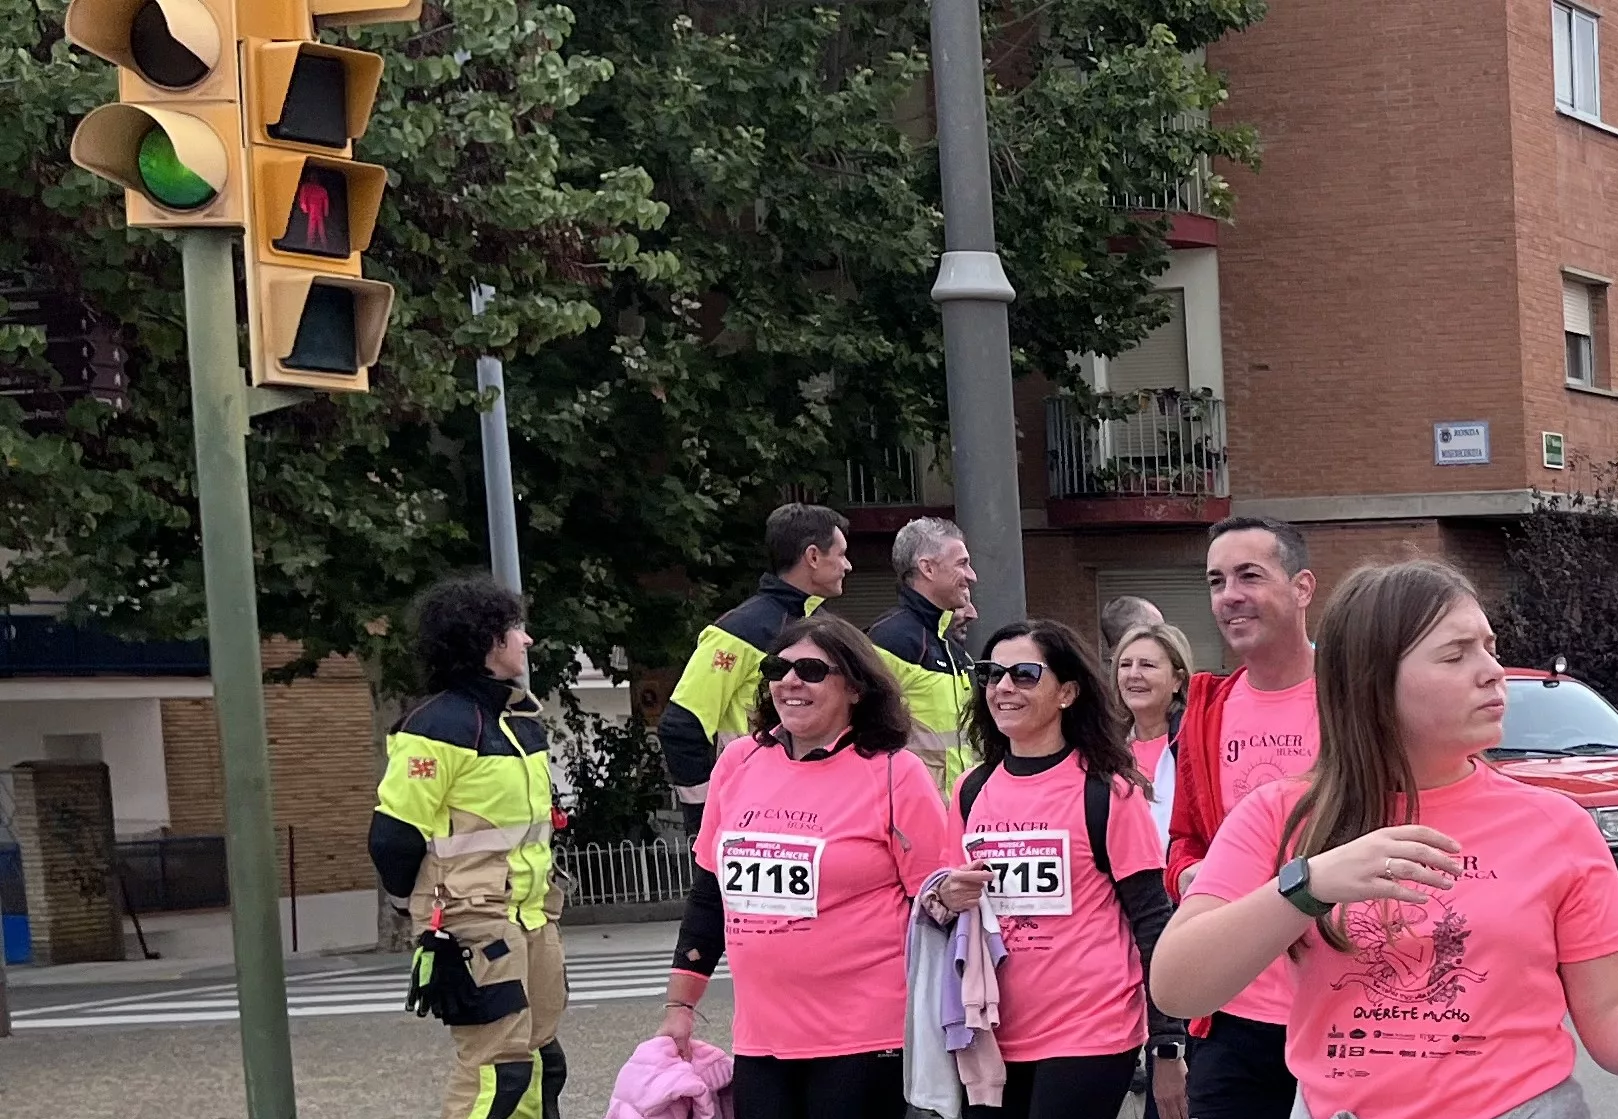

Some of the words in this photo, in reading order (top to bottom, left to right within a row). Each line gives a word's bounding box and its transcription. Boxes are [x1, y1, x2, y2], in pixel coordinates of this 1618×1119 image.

[1249, 731, 1303, 748] CÁNCER
[1276, 748, 1312, 758] HUESCA
[726, 847, 762, 858] CONTRA
[763, 849, 773, 858] EL
[774, 848, 810, 861] CÁNCER
[971, 849, 1006, 859] CONTRA
[1007, 848, 1018, 857] EL
[1019, 845, 1058, 857] CÁNCER
[726, 861, 810, 896] 2118
[1353, 1003, 1420, 1020] QUIÉRETE
[1423, 1008, 1470, 1023] MUCHO
